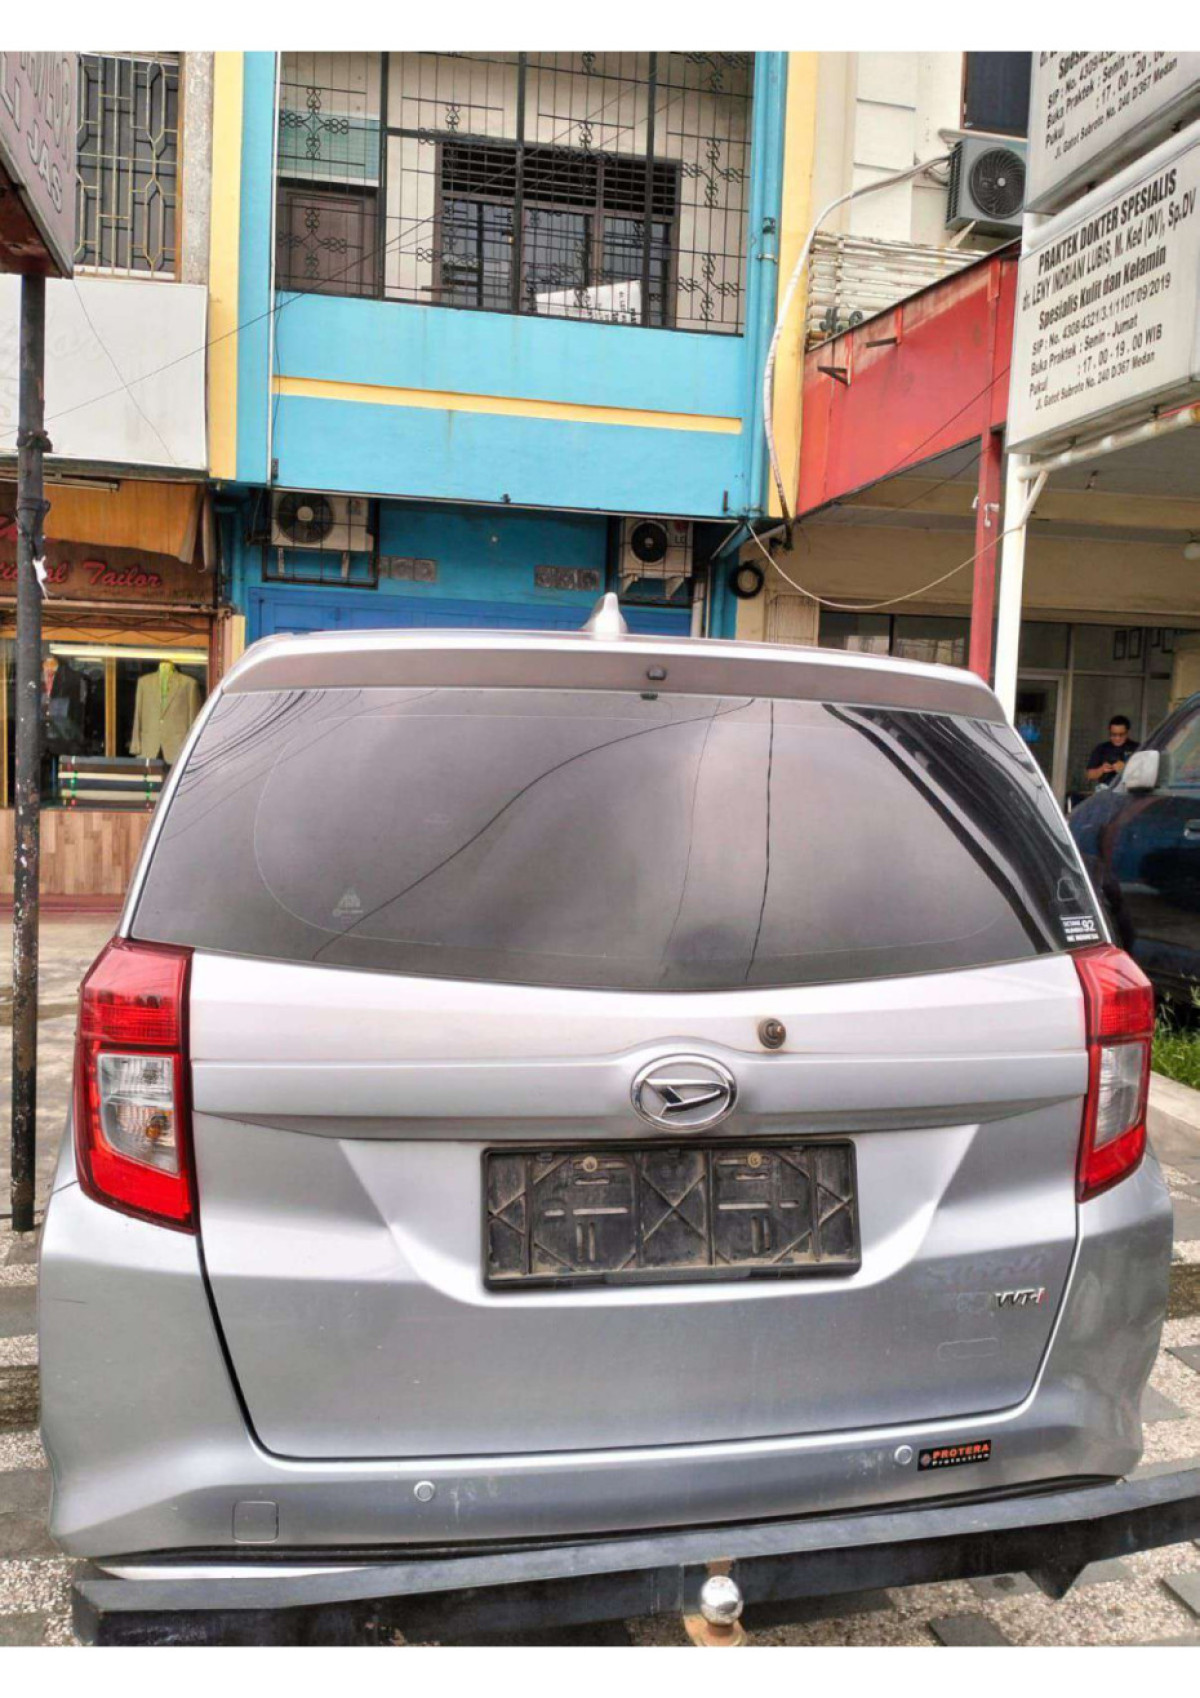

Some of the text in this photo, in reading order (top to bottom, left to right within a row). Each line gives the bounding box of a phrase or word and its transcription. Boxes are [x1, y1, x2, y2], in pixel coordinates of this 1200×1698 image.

[1153, 58, 1178, 84] Medan
[1038, 168, 1177, 276] PRAKTEK DOKTER SPESIALIS
[1032, 276, 1052, 306] LENY
[1052, 255, 1086, 295] INDRIANI
[1126, 219, 1144, 251] Ked
[1168, 187, 1197, 231] Sp.DV
[1039, 245, 1167, 331] Spesialis Kulit dan Kelamin
[1084, 331, 1105, 351] Senin
[1112, 313, 1138, 338] Jumat
[1145, 323, 1162, 345] WIB
[1131, 351, 1156, 370] Medan
[82, 560, 162, 588] Tailor
[932, 1443, 990, 1460] PROTERA
